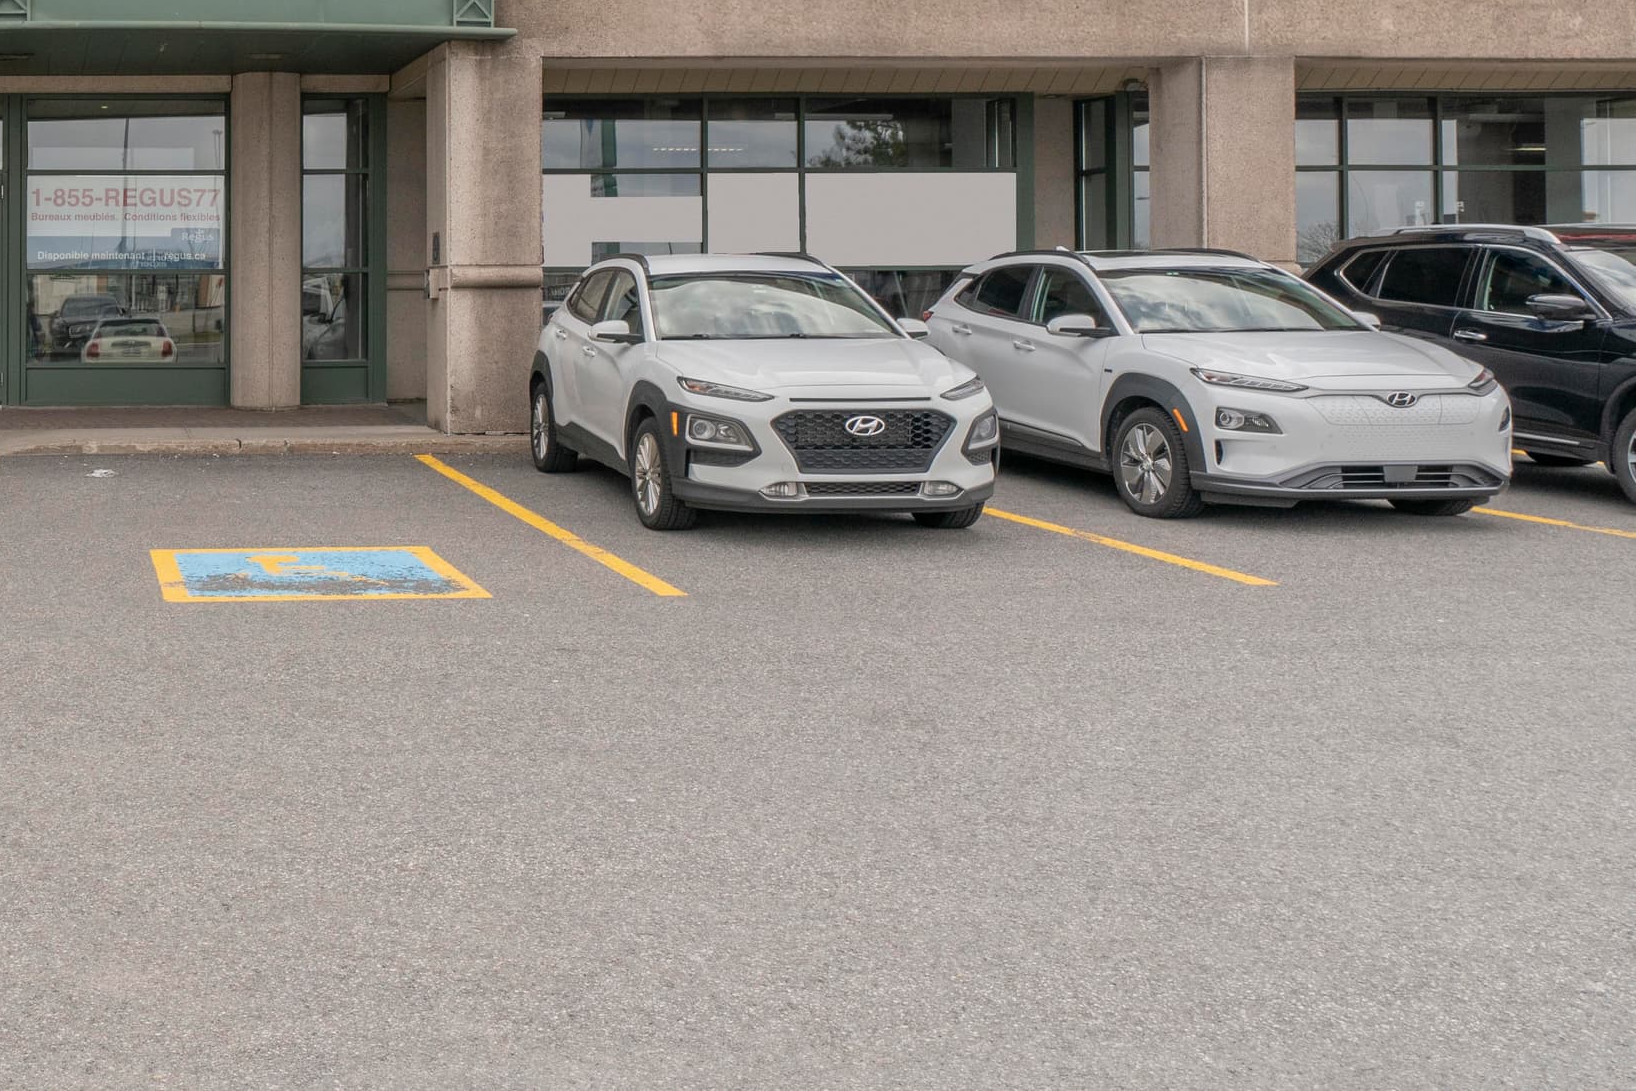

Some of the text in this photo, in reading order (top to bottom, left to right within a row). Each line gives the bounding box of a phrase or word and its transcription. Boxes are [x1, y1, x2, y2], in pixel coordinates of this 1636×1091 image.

[31, 188, 221, 207] 1-855-REGUS77
[31, 212, 71, 222] Bureaux
[124, 212, 177, 222] Conditions
[180, 212, 221, 222] flexibles
[37, 250, 145, 262] Disponible maintenant
